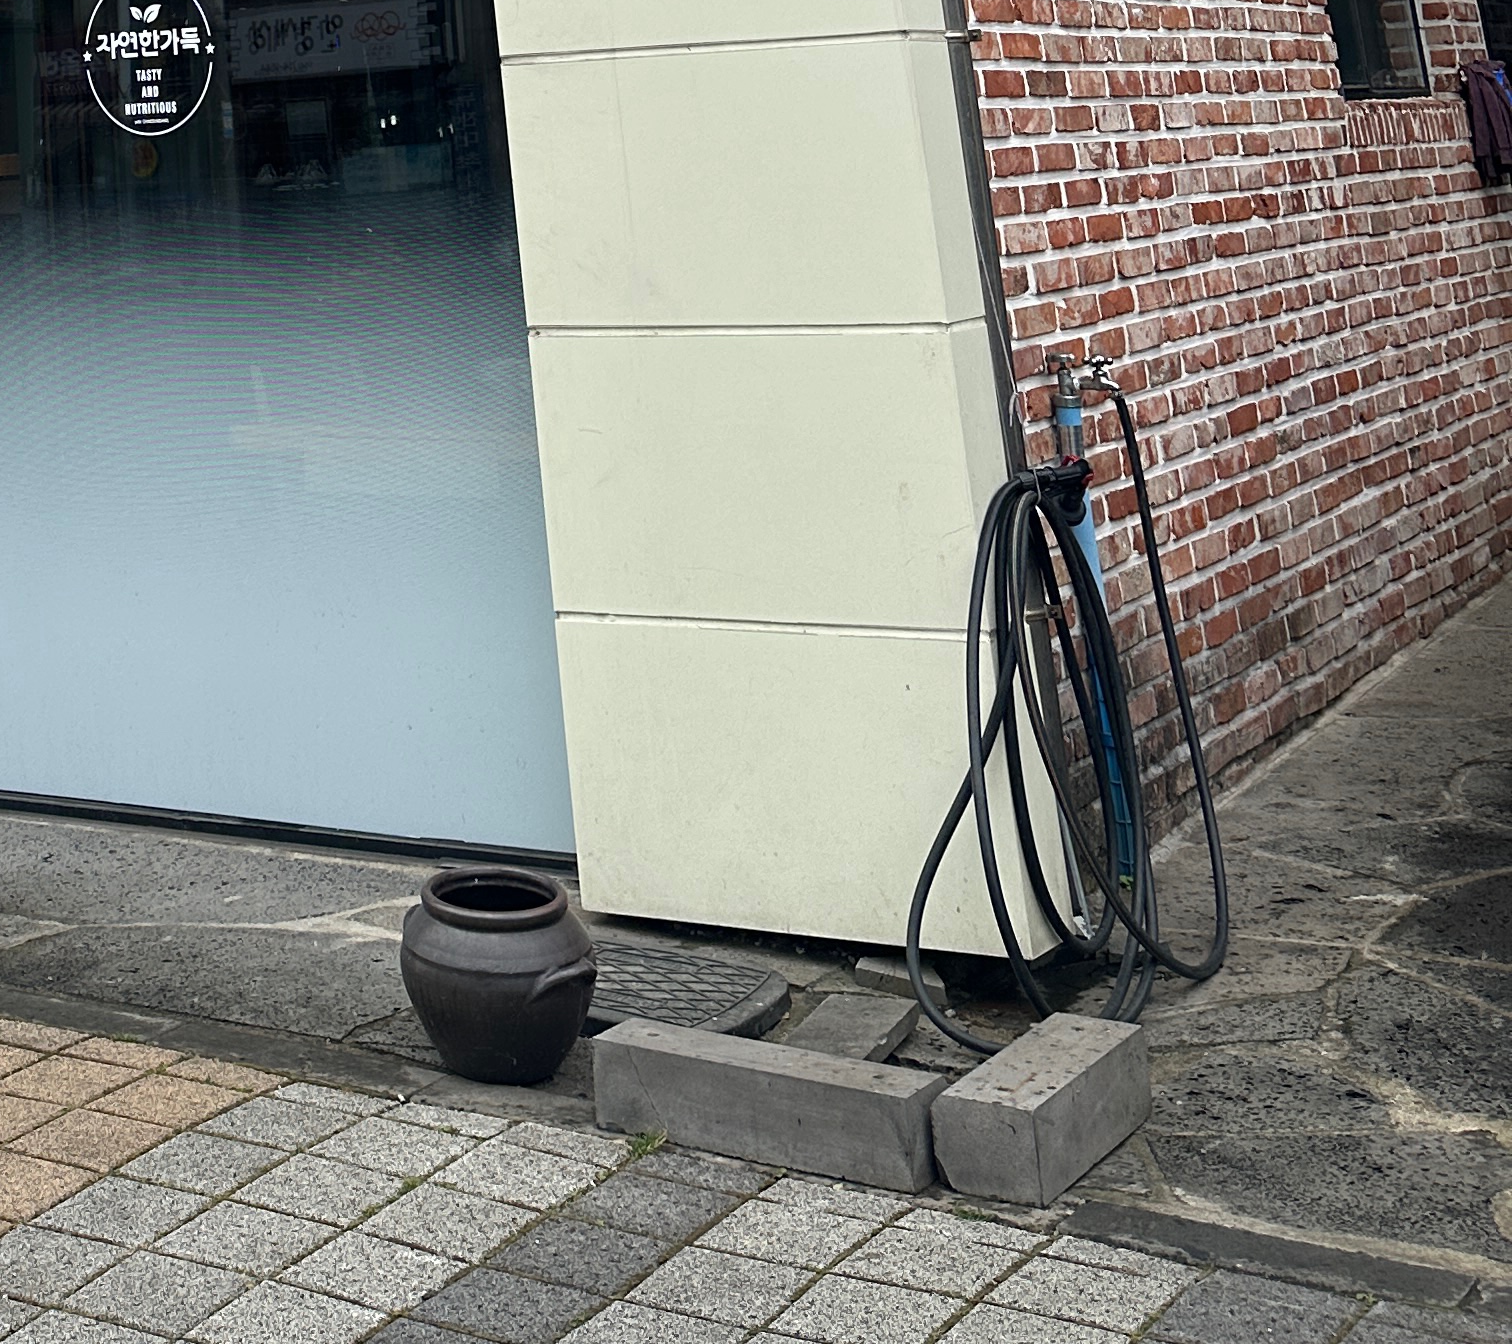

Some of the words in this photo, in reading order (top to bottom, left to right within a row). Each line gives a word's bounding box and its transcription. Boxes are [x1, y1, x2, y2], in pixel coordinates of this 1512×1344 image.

[95, 26, 201, 61] 자연한가득
[135, 68, 163, 82] TASTY
[141, 85, 159, 99] AND
[124, 100, 177, 116] NUTRITIOUS
